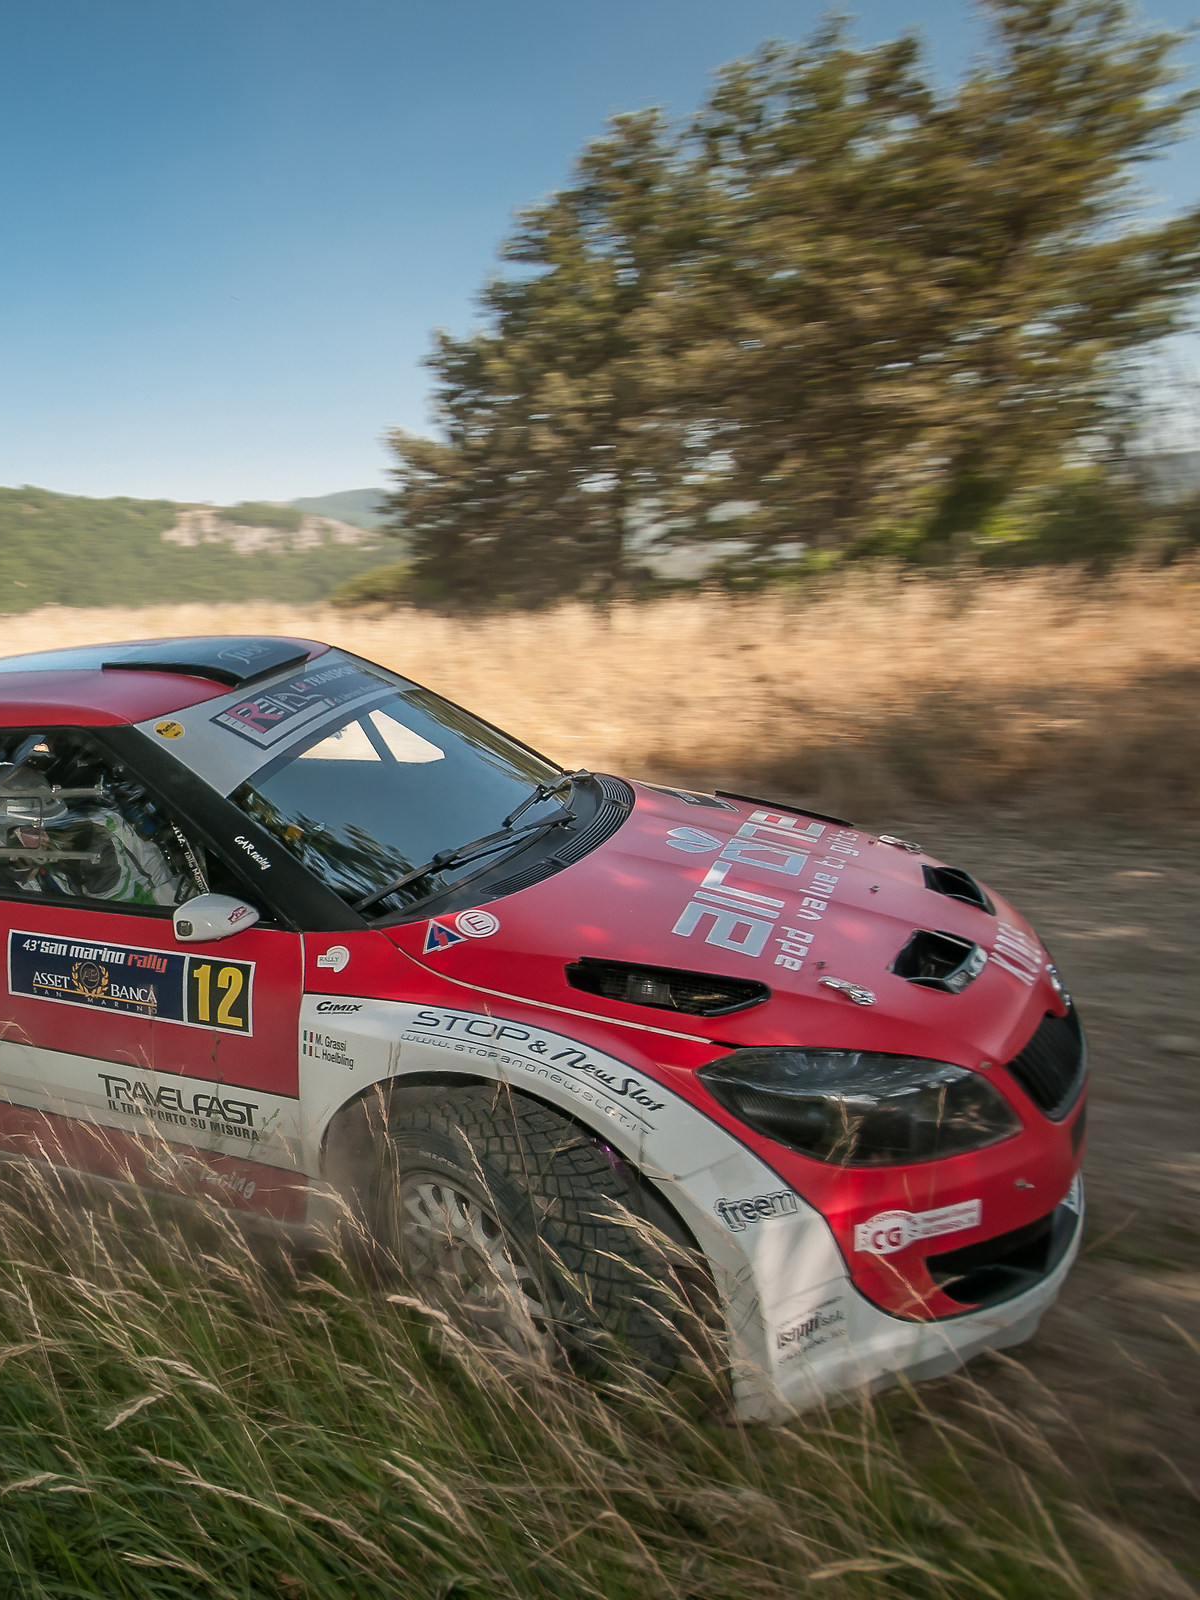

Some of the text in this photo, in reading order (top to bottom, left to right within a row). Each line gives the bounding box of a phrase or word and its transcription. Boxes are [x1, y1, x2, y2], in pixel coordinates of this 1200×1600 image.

[671, 809, 826, 958] airone
[813, 855, 847, 870] to
[796, 871, 839, 921] value
[40, 941, 68, 956] san
[69, 945, 126, 965] marino
[127, 953, 168, 974] rally
[774, 925, 815, 972] add
[33, 971, 70, 988] ASSET
[110, 983, 157, 1004] BANCA
[33, 987, 158, 1014] SAN MARINO
[193, 964, 243, 1027] 12
[315, 1033, 347, 1052] M. Grassi
[412, 1011, 531, 1041] STOP
[528, 1041, 548, 1055] &
[314, 1046, 354, 1071] L. Hoelbling
[97, 1073, 259, 1127] TRAVELFAST
[108, 1099, 119, 1112] IL
[190, 1117, 207, 1130] SU
[210, 1121, 260, 1142] MISURA
